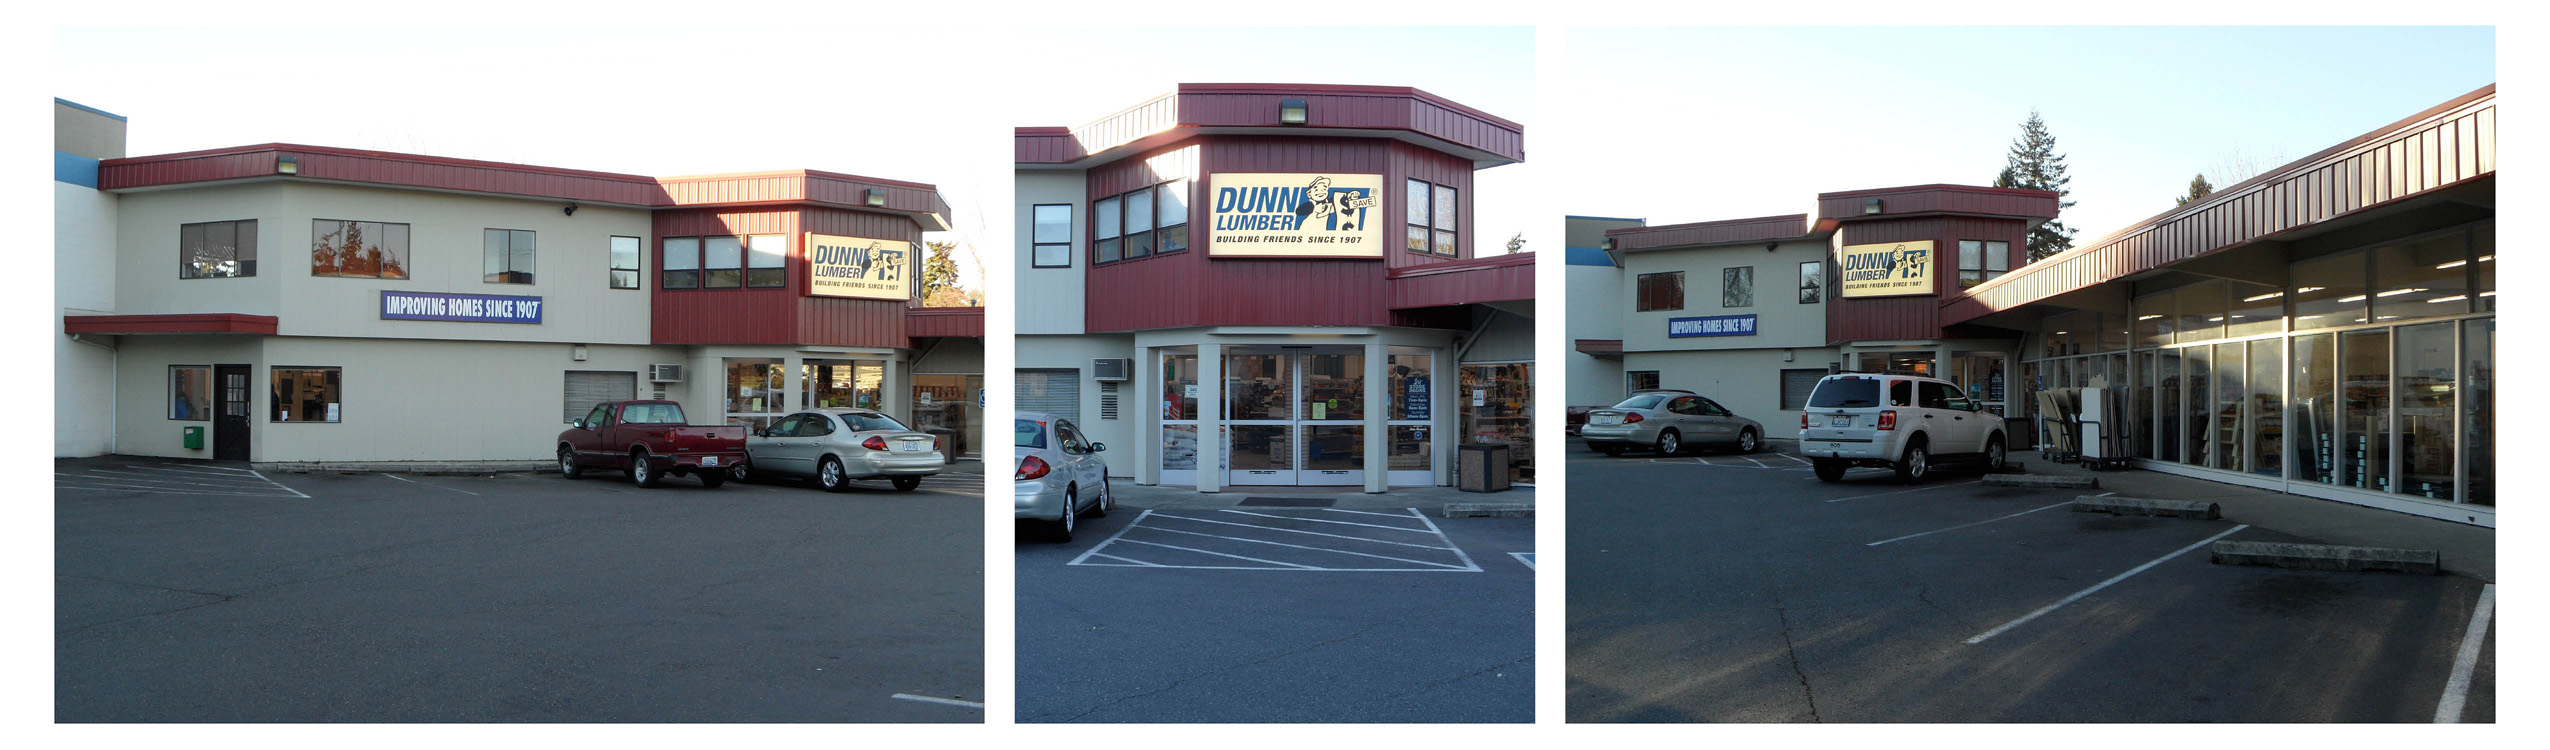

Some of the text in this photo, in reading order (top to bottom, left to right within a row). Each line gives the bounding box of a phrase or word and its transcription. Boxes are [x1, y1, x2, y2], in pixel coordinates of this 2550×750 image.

[1216, 187, 1300, 213] DUNN
[1353, 199, 1373, 208] SAVE
[1216, 215, 1294, 230] LUMBER
[1216, 235, 1260, 243] BUILDING
[1263, 235, 1303, 243] FRIENDS
[815, 245, 863, 266] DUNN
[1845, 252, 1889, 270] DUNN
[815, 265, 860, 279] LUMBER
[1846, 270, 1885, 281] LUMBER
[386, 296, 538, 319] IMPROVING HOMES SINCE 1907
[1671, 318, 1754, 334] IMPROVING HOMES SINCE 1907
